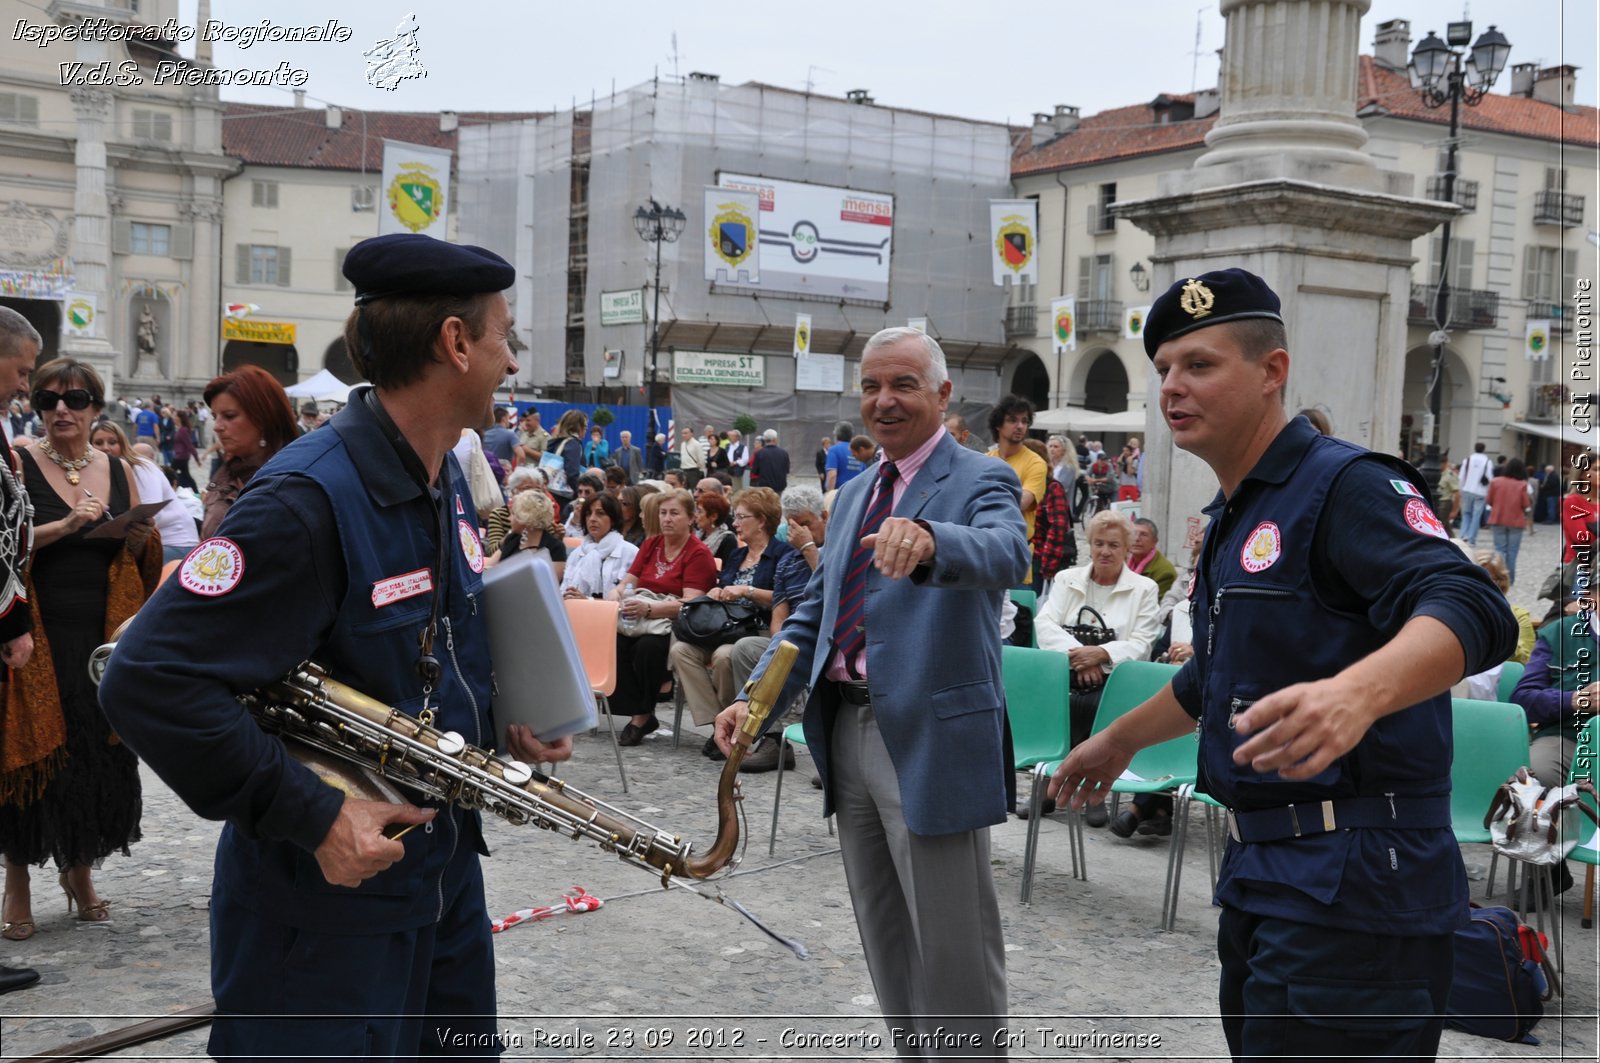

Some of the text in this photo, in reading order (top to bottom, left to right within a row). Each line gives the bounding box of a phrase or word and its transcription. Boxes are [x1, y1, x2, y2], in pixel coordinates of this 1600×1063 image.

[845, 199, 890, 215] mensa
[225, 328, 293, 341] BENEFICENZA
[704, 357, 753, 369] IMPRESA ST
[676, 368, 761, 378] EDILIZIA GENERALE
[210, 541, 231, 550] ROSSA
[230, 549, 241, 580] ITALIANA
[184, 571, 223, 591] FANFARA
[399, 583, 421, 594] MILITARE
